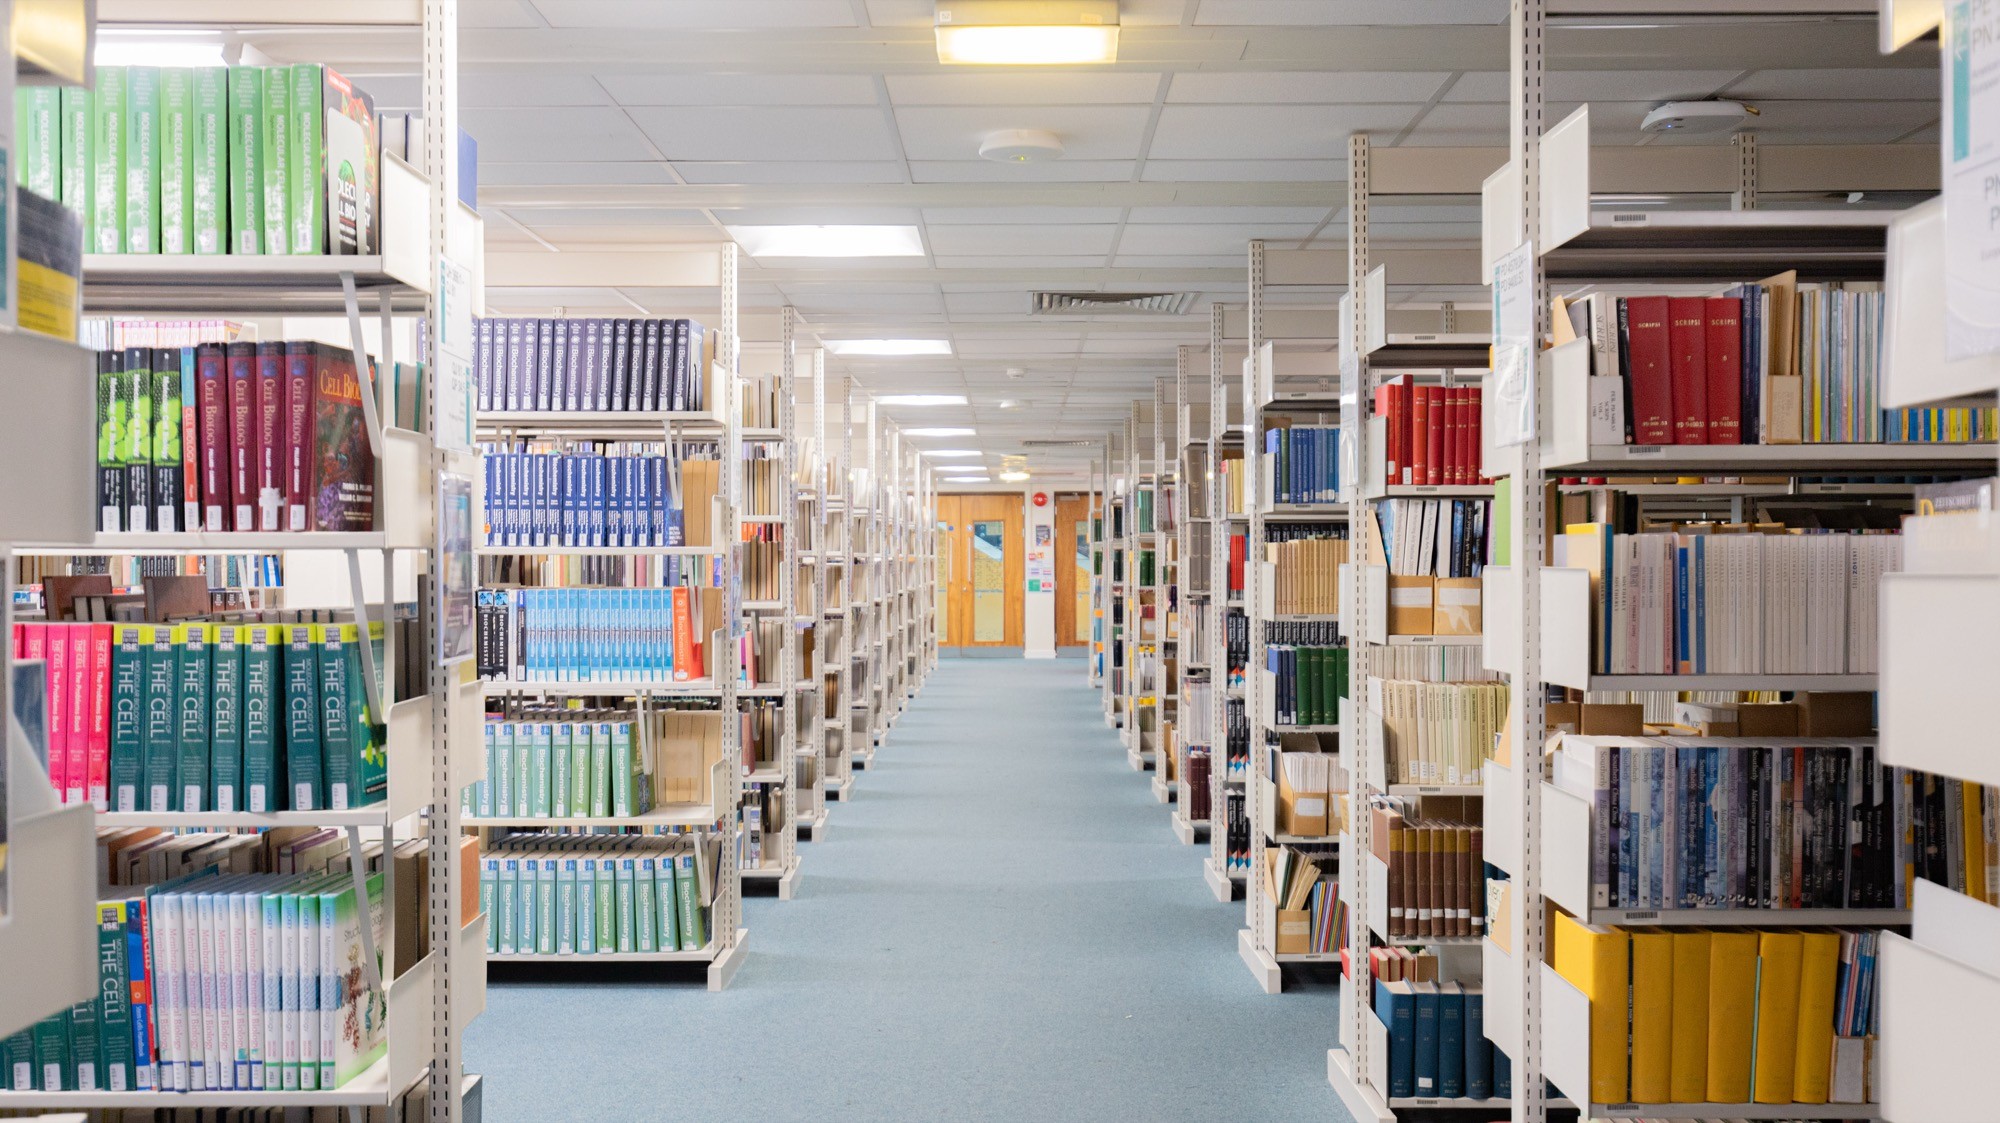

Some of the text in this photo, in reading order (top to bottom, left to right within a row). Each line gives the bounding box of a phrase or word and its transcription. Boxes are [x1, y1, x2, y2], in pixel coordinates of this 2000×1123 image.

[207, 114, 216, 167] MOLECULAR
[245, 114, 254, 191] MOLECULAR CELL
[277, 115, 286, 168] MOLECULAR
[303, 112, 312, 166] MOLECULAR
[1596, 315, 1606, 354] SCRIPSI
[1675, 319, 1701, 327] SCRIPSI
[1711, 318, 1737, 326] SCRIPSI
[320, 370, 342, 396] CELL
[481, 348, 489, 397] Biochemistry
[494, 348, 503, 397] Biochemistry
[509, 348, 518, 397] Biochemistry
[524, 348, 533, 397] Biochemistry
[540, 348, 549, 397] Biochemistry
[554, 348, 564, 397] Biochemistry
[569, 348, 578, 397] Biochemistry
[585, 348, 594, 397] Biochemistry
[599, 348, 609, 397] Biochemistry
[614, 348, 624, 397] Biochemistry
[630, 348, 640, 397] Biochemistry
[644, 348, 655, 397] Biochemistry
[660, 348, 670, 397] Biochemistry
[675, 348, 686, 397] Biochemistry
[185, 408, 194, 463] CELL BIOLOGY
[204, 380, 217, 447] CELL BIOLOGY
[235, 380, 248, 447] CELL BIOLOGY
[263, 379, 276, 446] CELL BIOLOGY
[293, 378, 305, 445] CELL BIOLOGY
[122, 643, 137, 651] ISE
[156, 643, 170, 651] ISE
[188, 642, 202, 650] ISE
[220, 642, 234, 650] ISE
[252, 643, 266, 651] ISE
[293, 641, 308, 649] ISE
[326, 641, 340, 649] ISE
[52, 684, 60, 715] Problems
[73, 684, 82, 733] Problems Book
[95, 684, 103, 715] Problems
[117, 660, 135, 739] THE CELL
[150, 660, 166, 738] THE CELL
[182, 659, 199, 738] THE CELL
[215, 659, 231, 738] THE CELL
[249, 660, 263, 739] THE CELL
[291, 659, 307, 738] THE CELL
[324, 659, 341, 737] THE CELL
[501, 748, 509, 805] Biochemistry
[519, 748, 528, 805] Biochemistry
[537, 748, 546, 805] Biochemistry
[556, 748, 565, 805] Biochemistry
[577, 748, 586, 805] Biochemistry
[597, 748, 605, 805] Biochemistry
[618, 748, 626, 805] Biochemistry
[1642, 752, 1650, 784] Southerly
[1599, 750, 1607, 856] Southerly Elizabeth Webby
[1750, 789, 1758, 824] Mid-century
[504, 884, 512, 940] Biochemistry
[524, 884, 532, 940] Biochemistry
[602, 884, 610, 940] Biochemistry
[621, 883, 629, 941] Biochemistry
[683, 881, 693, 938] Biochemistry
[201, 930, 211, 974] Membrane
[217, 930, 227, 975] Membrane
[101, 939, 119, 1019] THE CELL
[155, 928, 164, 974] Membrane
[160, 1019, 168, 1050] Biology
[169, 928, 179, 974] Membrane
[174, 1020, 183, 1050] Biology
[187, 928, 195, 973] Membrane
[191, 1019, 199, 1050] Biology
[137, 1031, 145, 1057] Handbook
[205, 1020, 214, 1051] Biology
[221, 1020, 230, 1051] Biology
